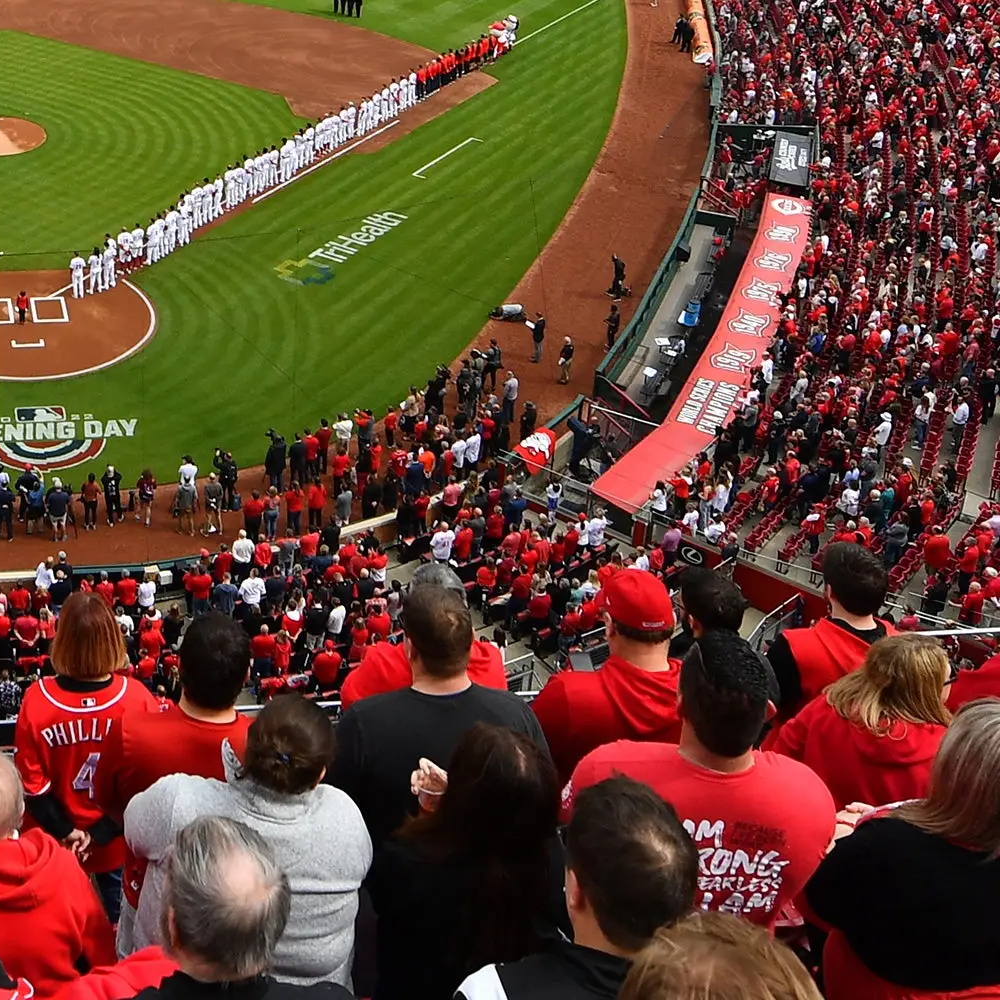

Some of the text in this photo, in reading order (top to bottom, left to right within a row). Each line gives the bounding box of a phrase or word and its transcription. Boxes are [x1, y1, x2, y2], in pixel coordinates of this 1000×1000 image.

[308, 210, 409, 264] TriHealth
[696, 381, 741, 436] CHAMPIONS
[84, 419, 138, 439] DAY
[40, 717, 113, 748] PHILLI
[72, 751, 101, 800] 4
[697, 847, 790, 878] RONG
[697, 875, 783, 893] EARLESS
